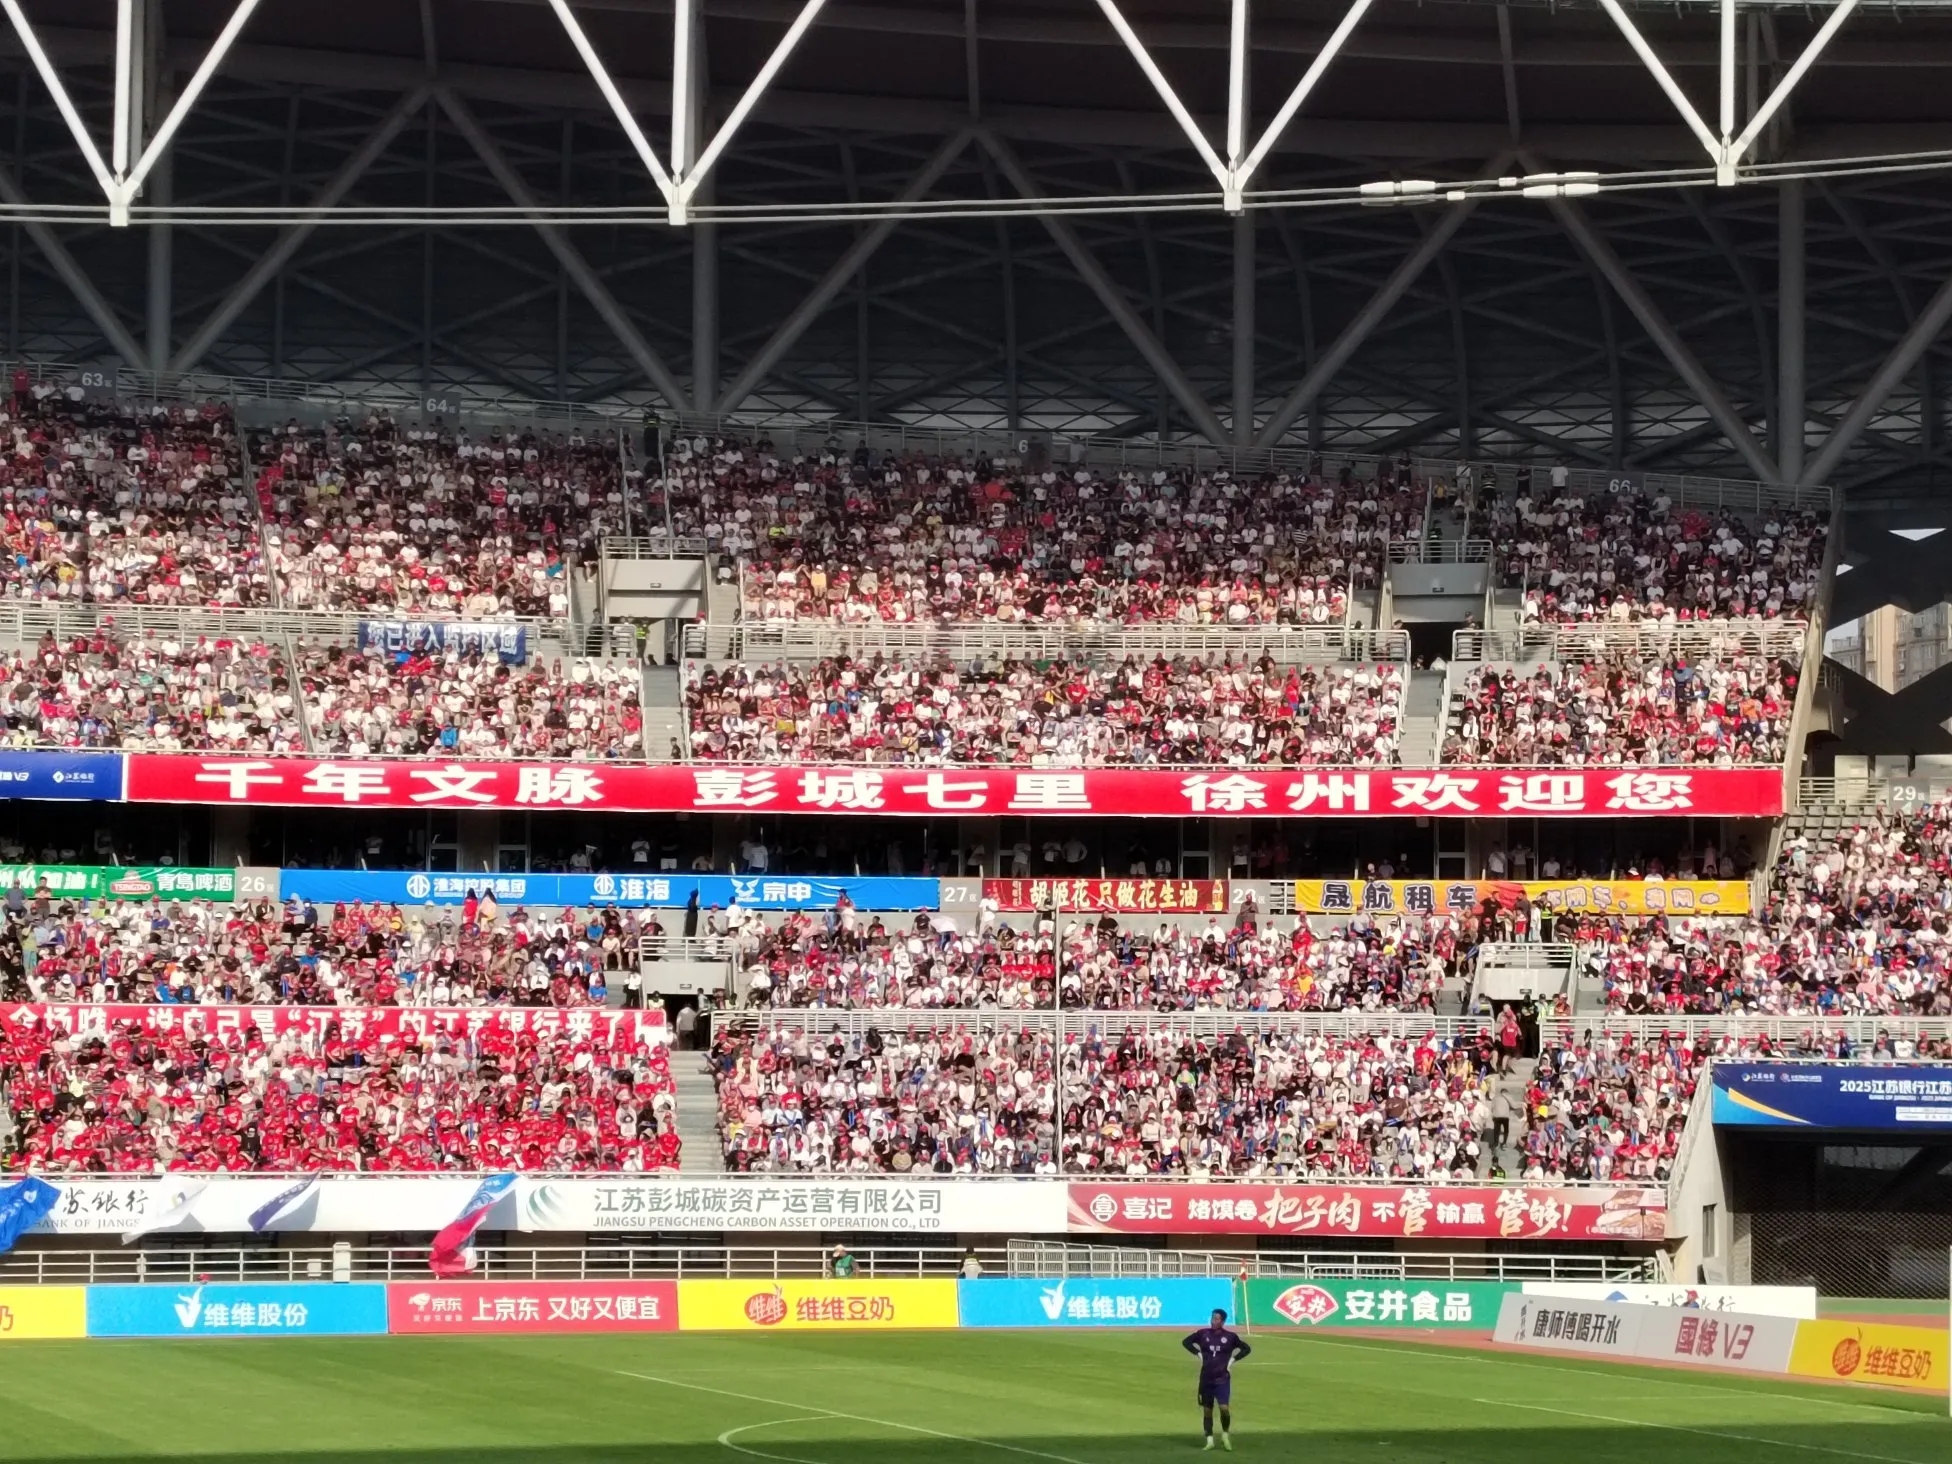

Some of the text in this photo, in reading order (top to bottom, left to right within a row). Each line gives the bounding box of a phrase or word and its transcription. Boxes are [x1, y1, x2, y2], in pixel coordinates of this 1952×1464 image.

[195, 761, 1693, 811] 千年文脉 彭城七里 徐州欢迎您
[156, 872, 233, 892] 青岛啤酒
[433, 878, 526, 893] 淮海控股集团
[619, 879, 670, 900] 淮海
[762, 882, 812, 902] 宗申
[1029, 879, 1091, 910] 胡姬花
[1097, 880, 1199, 911] 只做花生油
[1322, 882, 1476, 911] 晟航租车
[593, 1187, 942, 1214] 江苏彭城碳资产运营有限公司
[1122, 1197, 1173, 1220] 喜记
[593, 1216, 646, 1228] JIANGSU
[649, 1216, 724, 1228] PENGCHENG
[727, 1216, 777, 1228] CARBON
[779, 1216, 817, 1228] ASSET
[820, 1216, 889, 1228] OPERATION
[919, 1216, 940, 1228] LTD
[203, 1302, 309, 1328] 维维股份
[432, 1297, 463, 1312] 京东
[471, 1296, 662, 1322] 上京东 又好又便宜
[795, 1296, 895, 1322] 维维豆奶
[1067, 1295, 1163, 1320] 维维股份
[1286, 1294, 1327, 1316] 安井
[1344, 1289, 1472, 1322] 安井食品
[1532, 1309, 1622, 1345] 康师傅喝开水
[1724, 1322, 1755, 1360] V3
[1863, 1344, 1932, 1381] 维维豆奶
